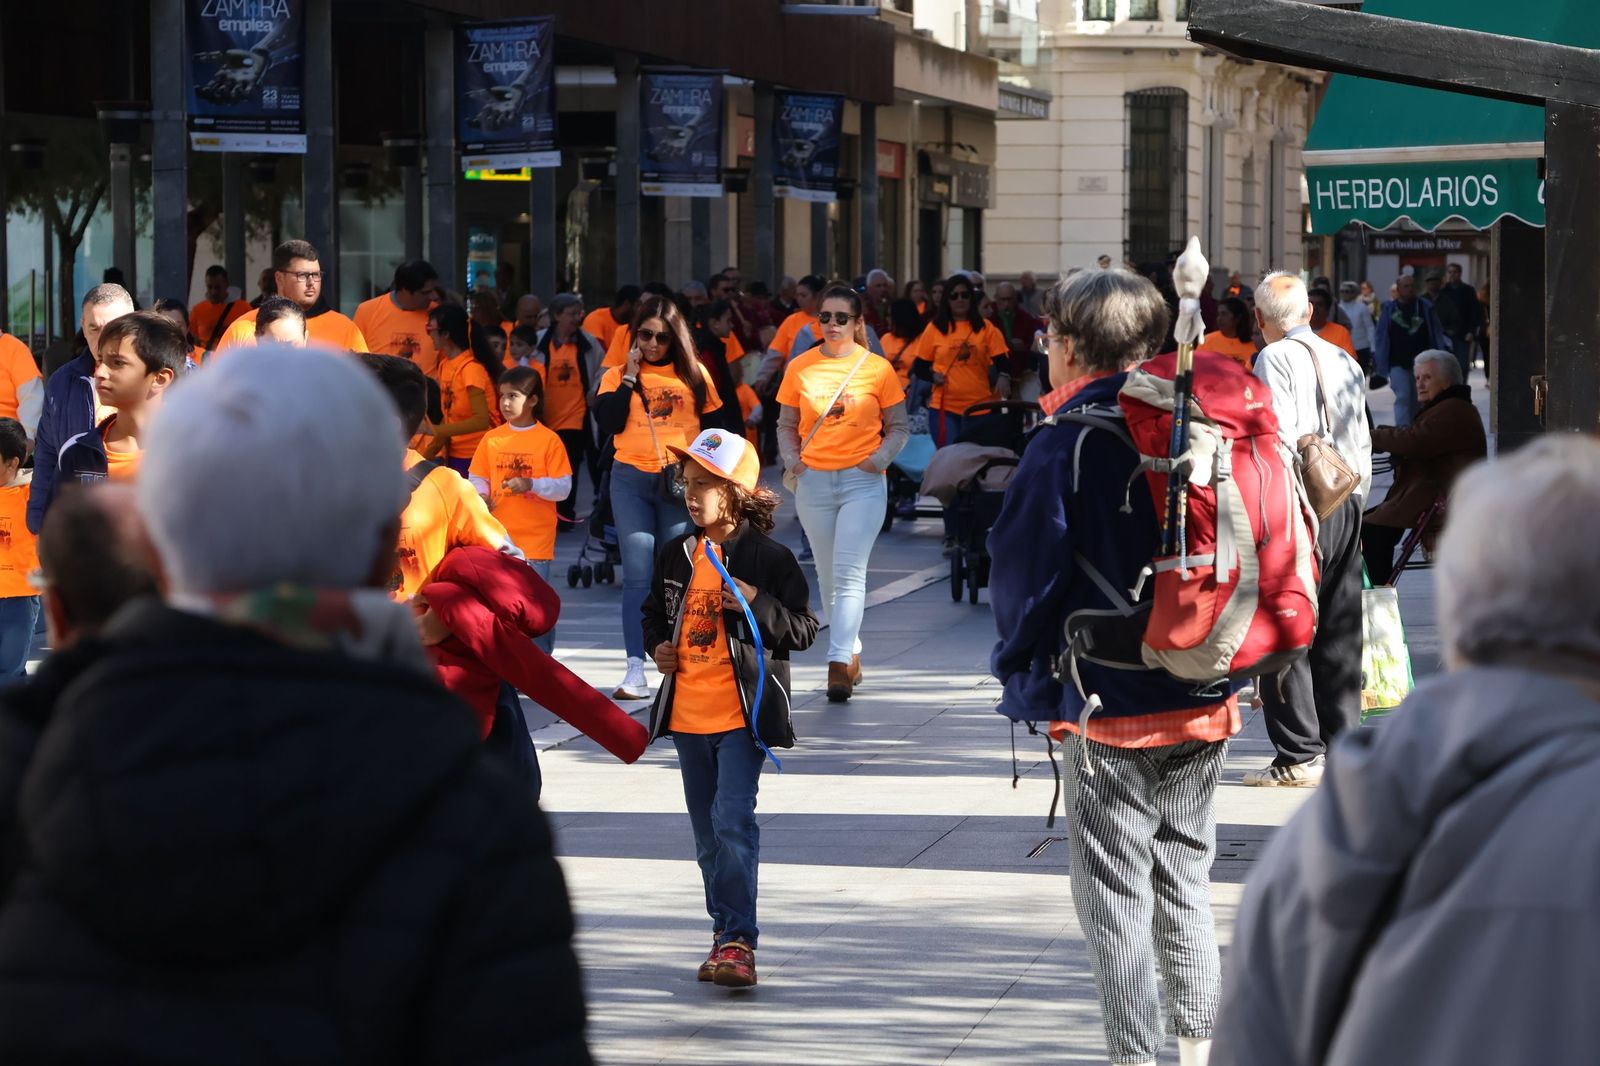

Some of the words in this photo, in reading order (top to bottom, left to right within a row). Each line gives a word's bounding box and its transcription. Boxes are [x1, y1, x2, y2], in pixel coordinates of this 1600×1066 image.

[218, 18, 272, 35] emplea
[483, 61, 528, 75] emplea
[262, 89, 277, 99] 23
[1316, 174, 1499, 210] HERBOLARIOS
[1375, 238, 1435, 249] Herbolario
[1437, 238, 1462, 249] Diez
